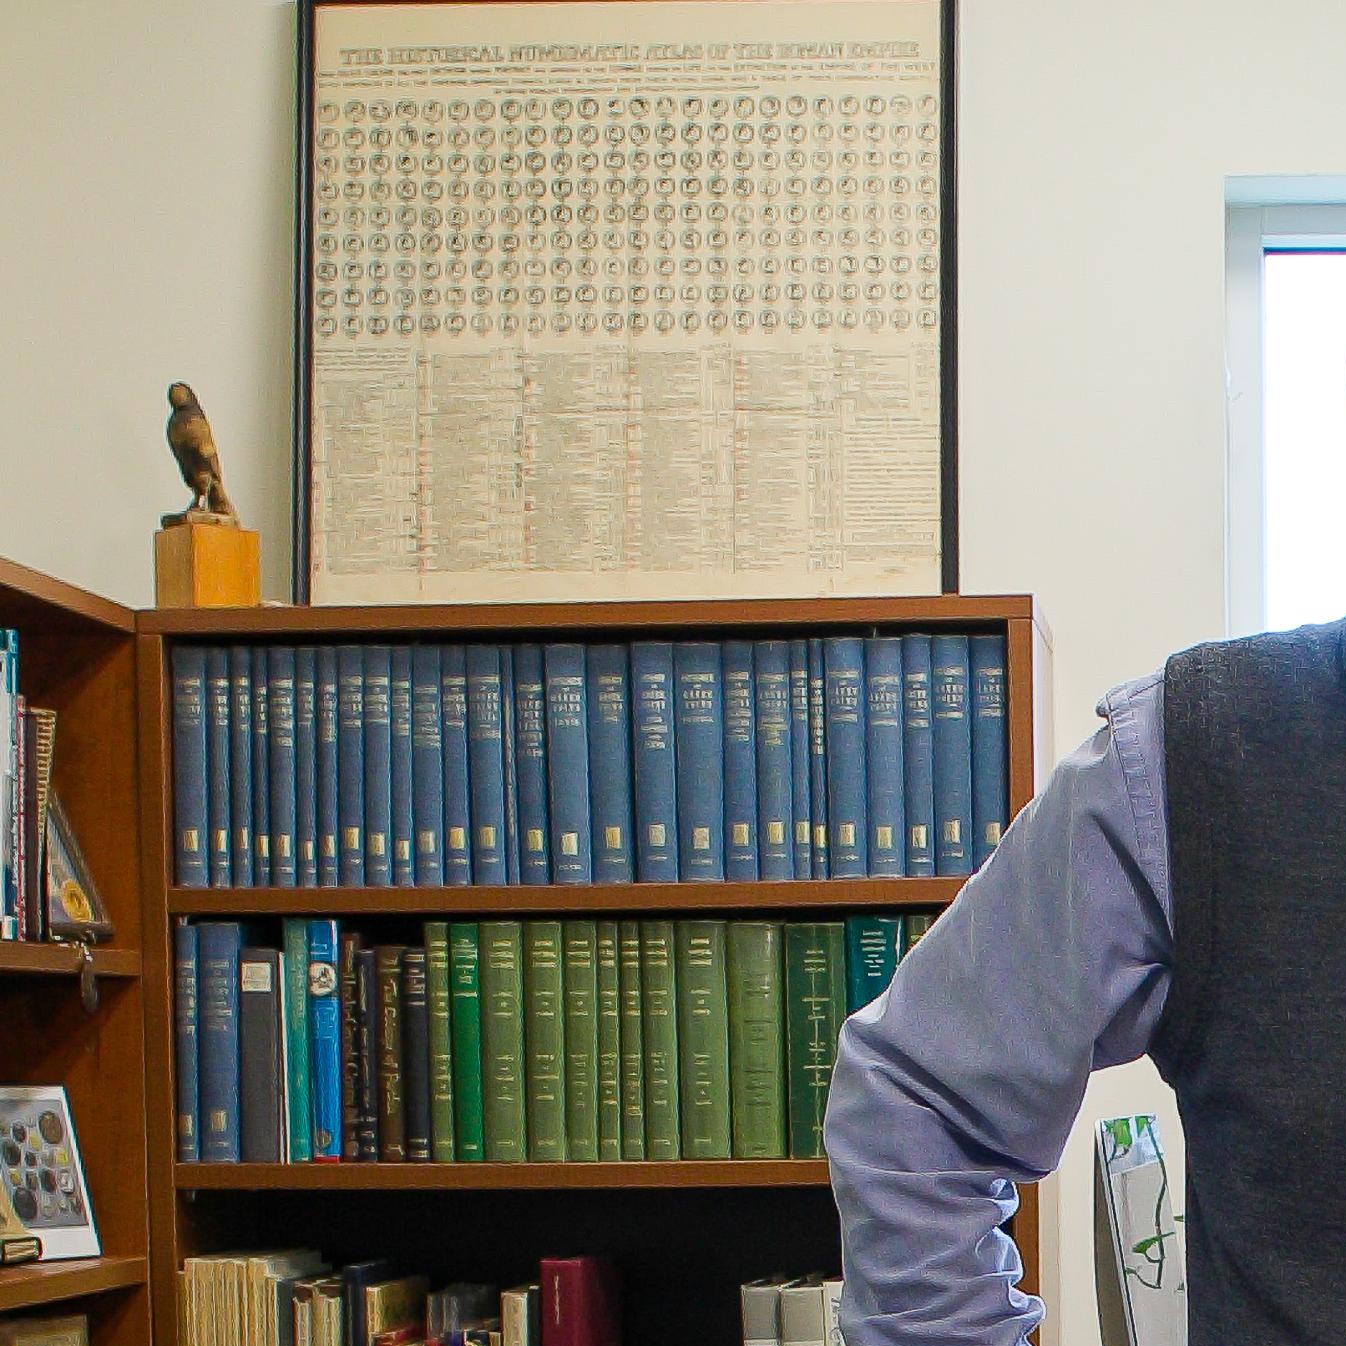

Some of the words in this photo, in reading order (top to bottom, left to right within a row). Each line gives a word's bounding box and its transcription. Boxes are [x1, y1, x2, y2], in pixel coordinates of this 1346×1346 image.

[340, 47, 383, 65] THE
[387, 46, 505, 64] HISTORICAL
[509, 45, 639, 63] NUMISMATIC
[645, 44, 703, 60] ATLAS
[708, 43, 729, 60] OF
[734, 43, 774, 59] THE
[848, 41, 920, 58] EMPIRE
